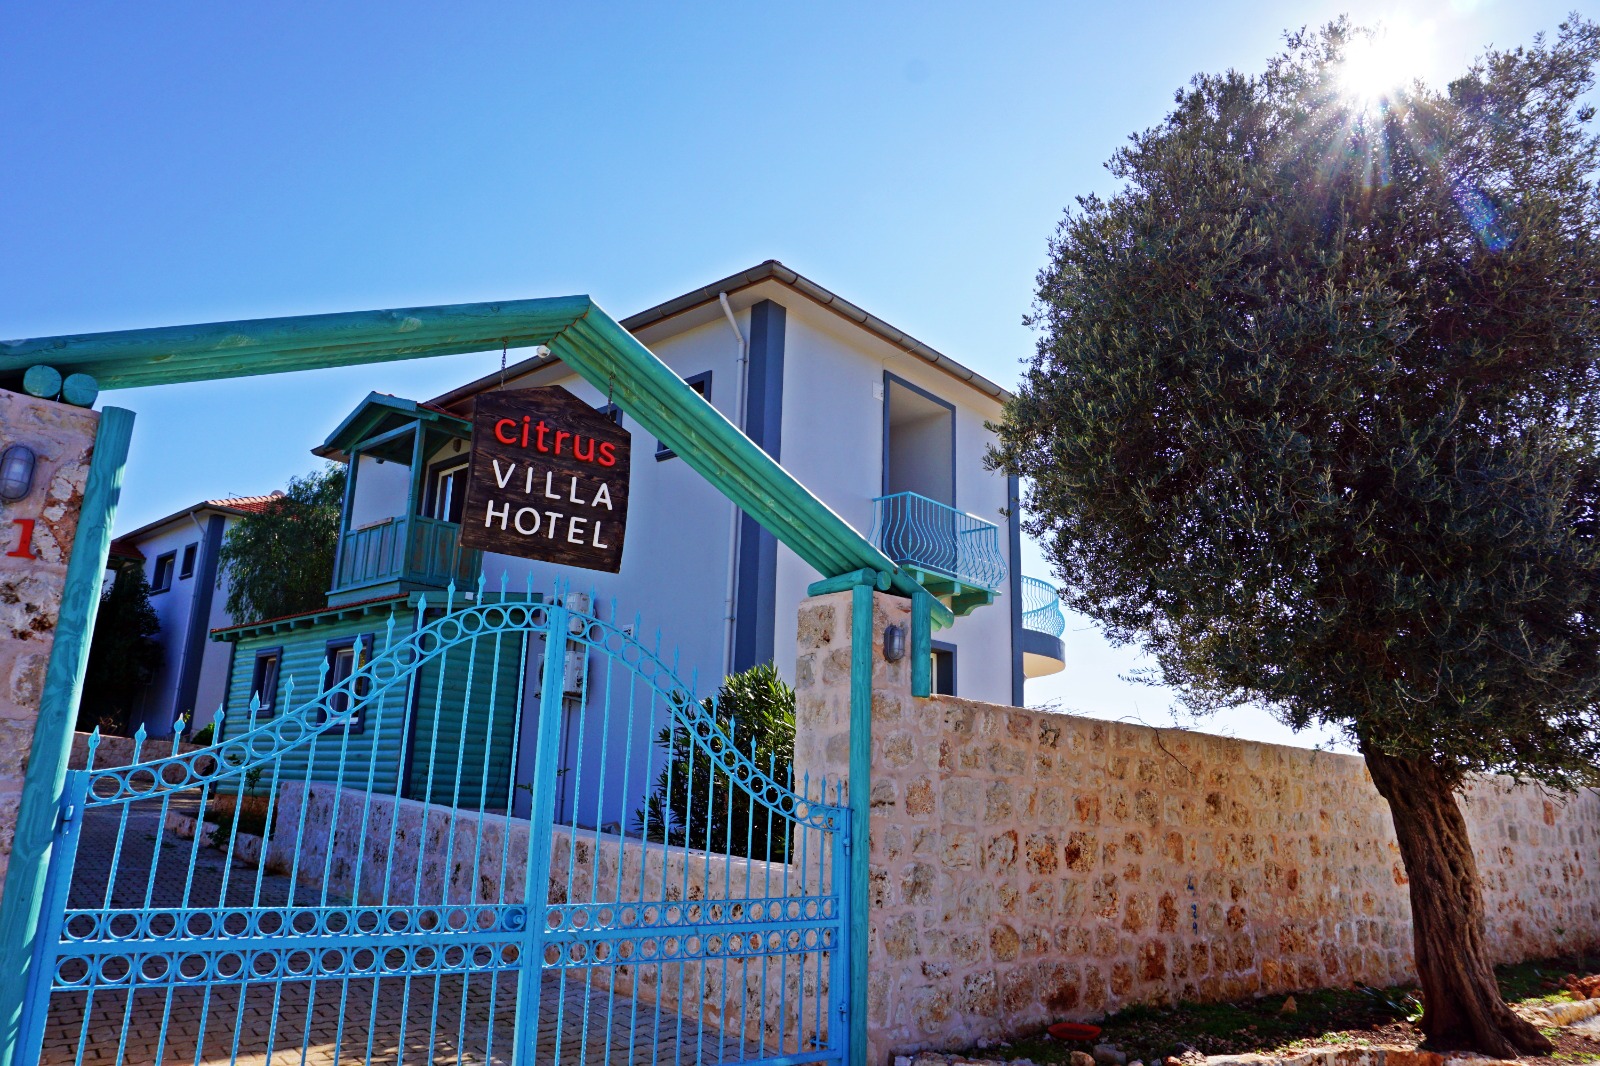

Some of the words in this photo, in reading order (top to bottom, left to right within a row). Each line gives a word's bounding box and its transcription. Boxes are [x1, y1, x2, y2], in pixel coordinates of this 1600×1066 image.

[494, 415, 616, 467] citrus
[492, 459, 613, 511] VILLA
[6, 518, 37, 560] 1
[484, 499, 608, 549] HOTEL
